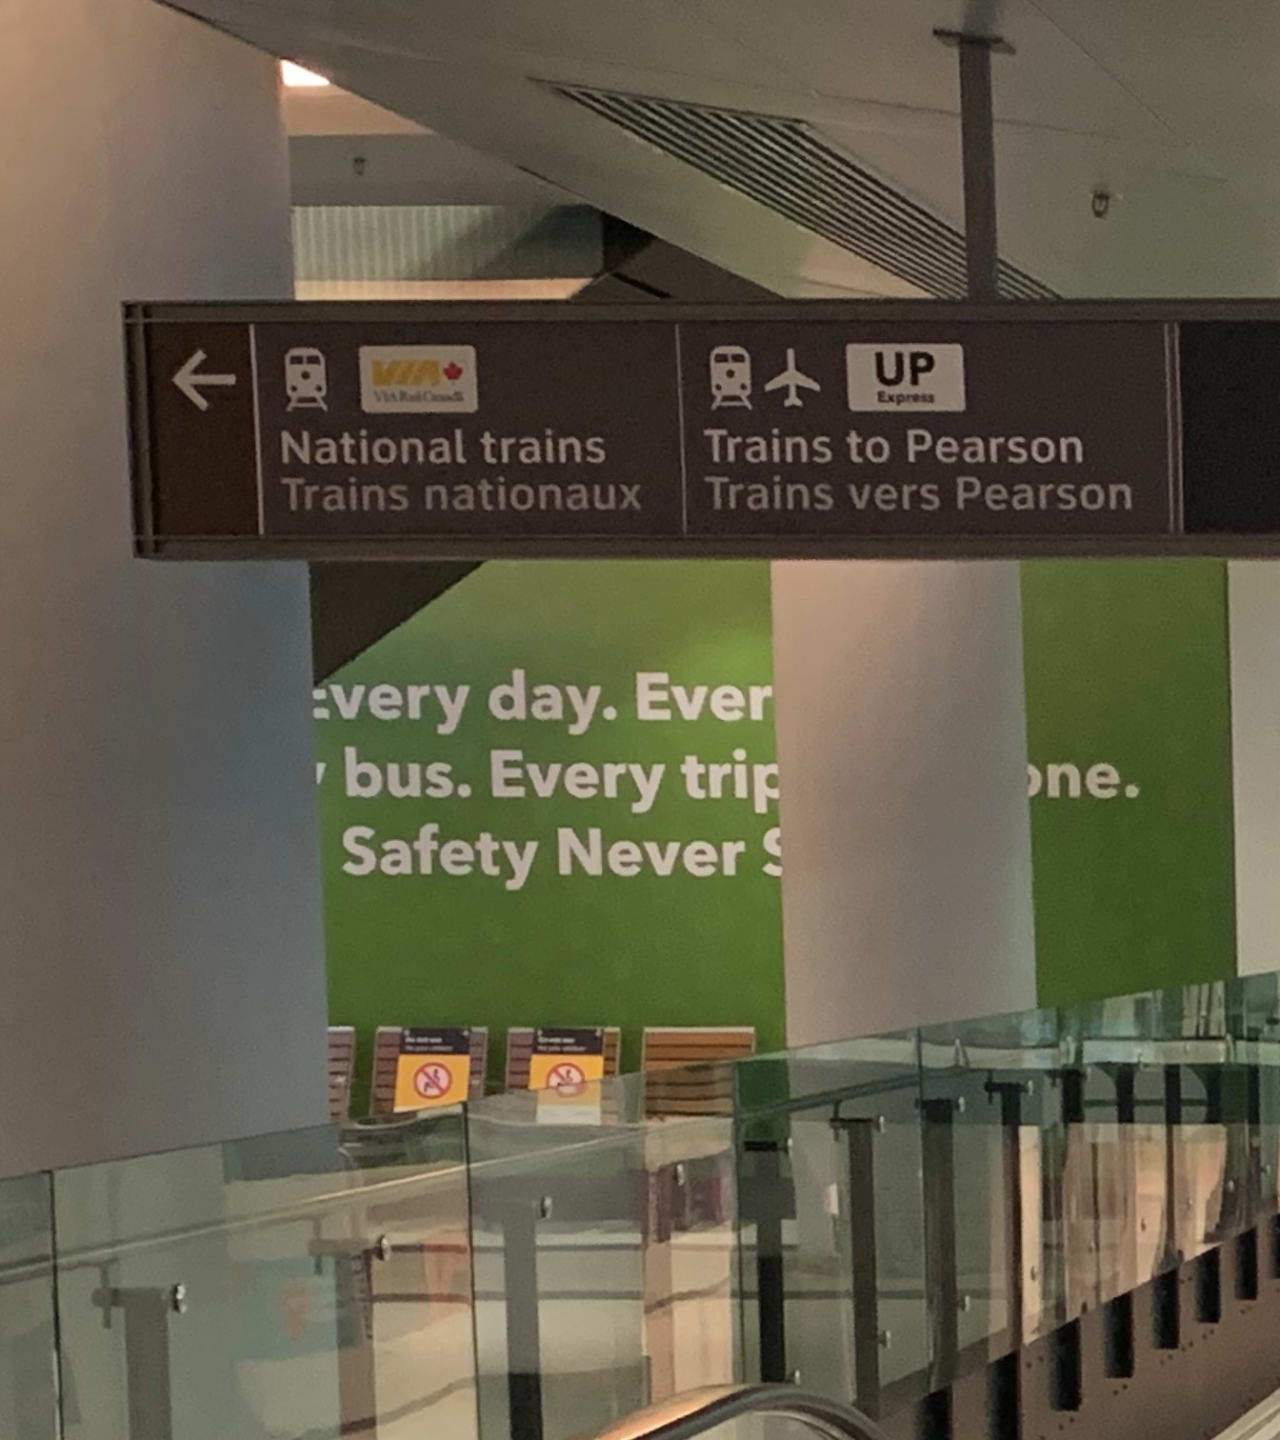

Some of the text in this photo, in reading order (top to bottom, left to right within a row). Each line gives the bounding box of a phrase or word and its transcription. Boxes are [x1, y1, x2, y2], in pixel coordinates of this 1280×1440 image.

[371, 360, 440, 385] VIA
[874, 353, 935, 387] UP
[877, 391, 935, 407] Express
[281, 430, 605, 465] National trains
[704, 429, 1083, 464] Trains to Pearson
[282, 477, 641, 511] Trains nationaux
[705, 477, 1131, 511] Trains vers Pearson
[488, 669, 617, 735] day.
[636, 671, 773, 722] Ever
[345, 747, 471, 799] bus.
[491, 749, 664, 813] Every
[680, 748, 780, 814] trip
[341, 823, 538, 890] Safety
[560, 827, 746, 877] Never
